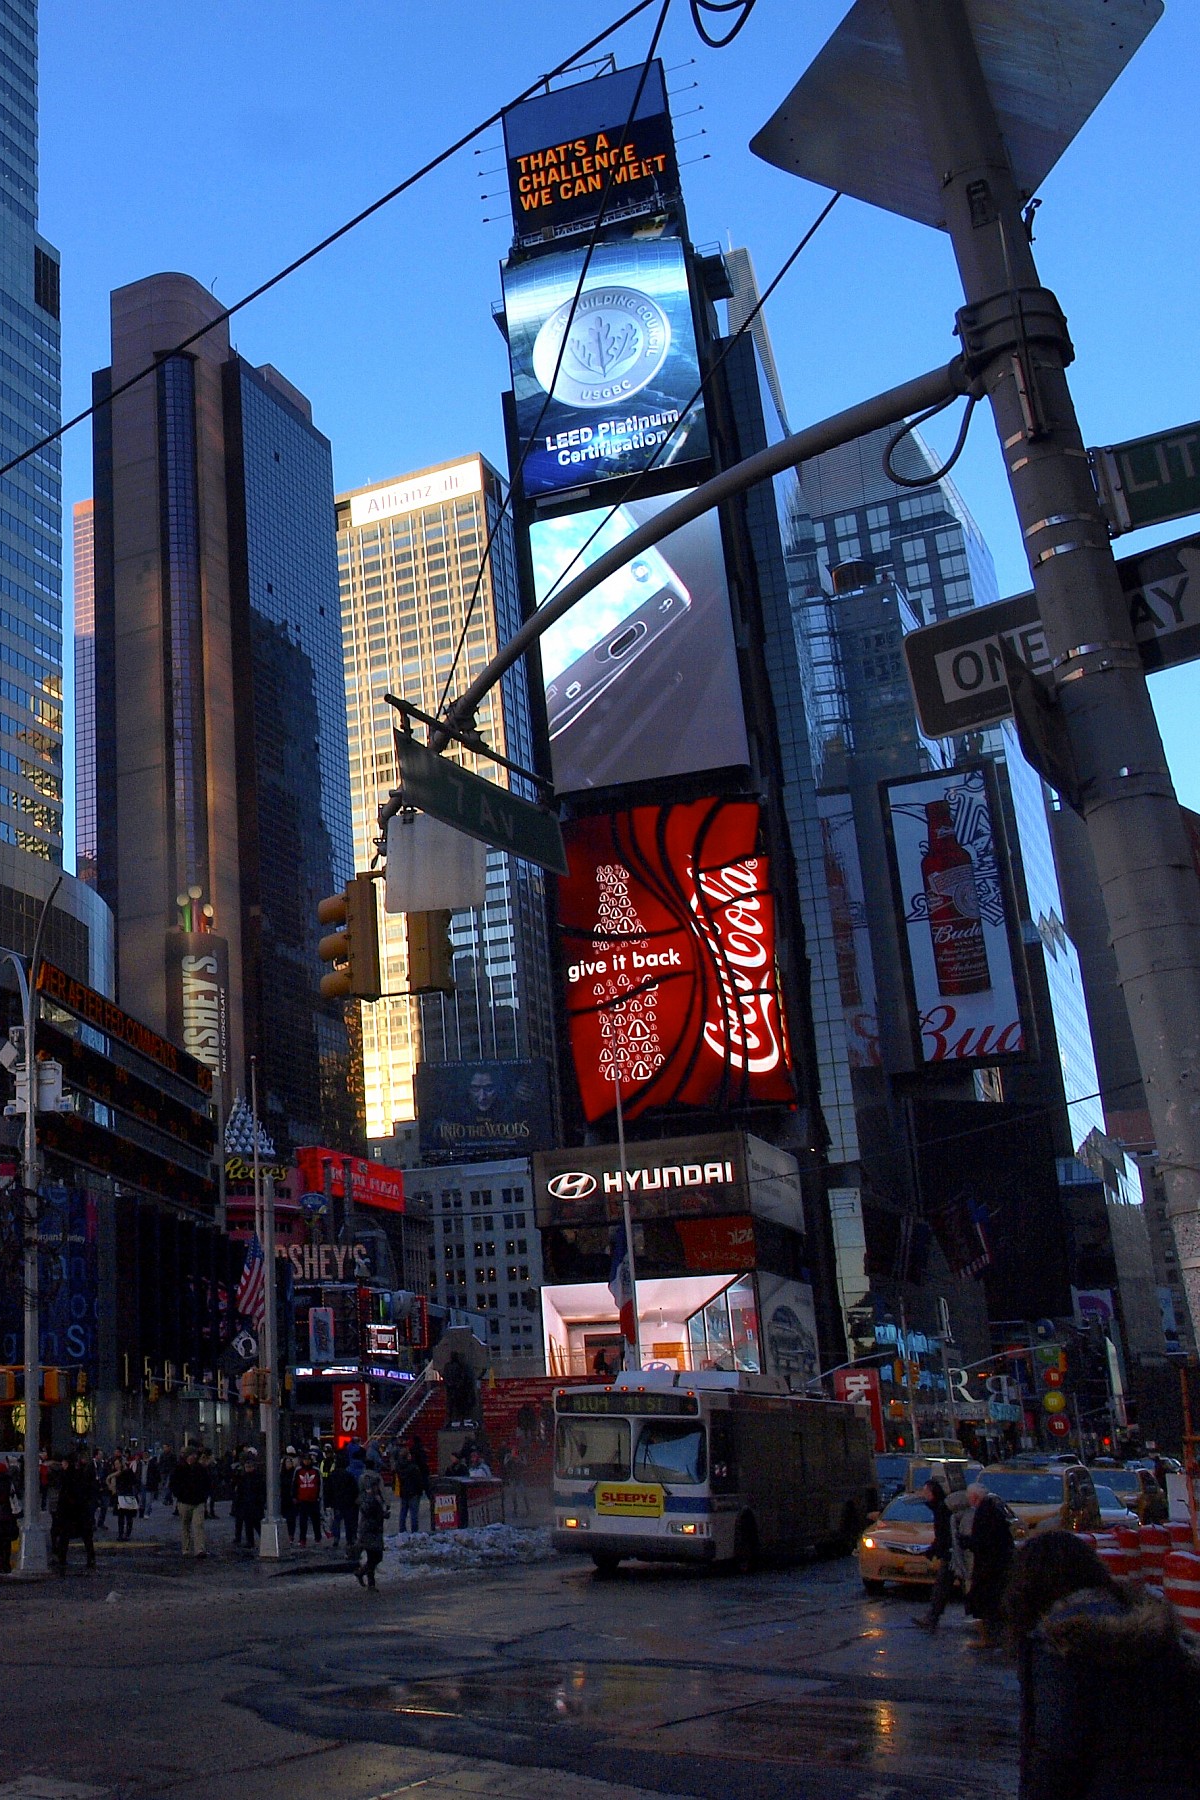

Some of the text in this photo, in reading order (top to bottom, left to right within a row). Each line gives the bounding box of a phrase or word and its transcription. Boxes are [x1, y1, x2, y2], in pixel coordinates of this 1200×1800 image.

[517, 133, 610, 174] THAT'S A
[520, 154, 666, 212] WE CAN MEET
[636, 304, 659, 357] COUNCIL
[581, 379, 632, 401] USGBC
[545, 409, 679, 451] LEED Platinum
[557, 429, 668, 466] Certification
[367, 485, 432, 514] Allianz
[1131, 576, 1189, 633] AY
[568, 948, 681, 983] give it back
[182, 955, 220, 1076] RSHEY'S
[484, 1120, 530, 1138] WOODS
[603, 1161, 734, 1193] HYUNDAI
[275, 1243, 370, 1281] SHEY'S
[341, 1387, 361, 1433] tkts
